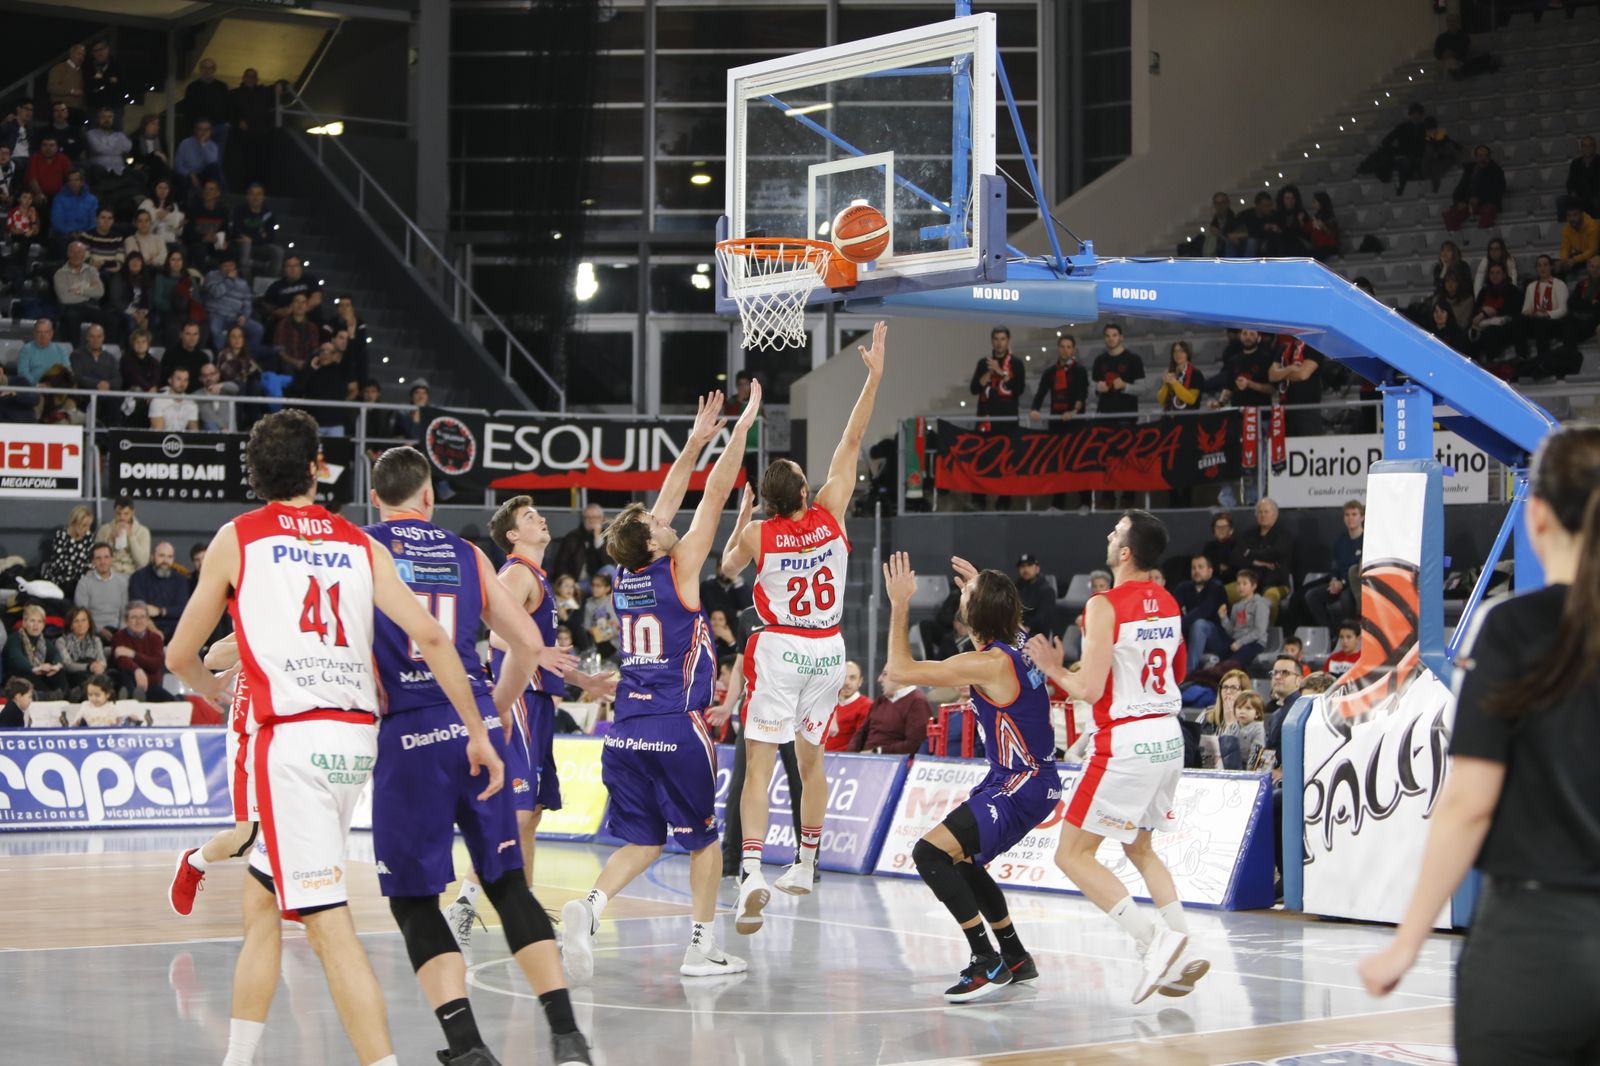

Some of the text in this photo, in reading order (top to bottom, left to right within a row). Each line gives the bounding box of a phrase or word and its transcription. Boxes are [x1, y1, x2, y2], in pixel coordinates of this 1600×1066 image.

[972, 287, 1019, 301] MONDO
[1112, 287, 1157, 301] MONDO
[1396, 398, 1406, 451] MONDO
[483, 422, 732, 472] ESQUINA
[0, 441, 79, 470] ar
[1289, 444, 1486, 477] Diario Ptino
[119, 463, 226, 481] DONDE DANI
[1, 477, 57, 489] MEGAFONÍA
[120, 488, 225, 498] GASTROBAR
[1308, 487, 1337, 496] Cuando
[278, 514, 333, 536] OLMOS
[390, 526, 446, 541] GUSTYS
[775, 525, 832, 548] CARLINHOS
[272, 545, 352, 568] PULEVA
[416, 550, 457, 558] Palencia
[780, 549, 832, 571] PULEVA
[623, 581, 652, 590] Palencia
[787, 566, 836, 616] 26
[299, 575, 349, 647] 41
[621, 613, 662, 656] 10
[1136, 626, 1174, 641] PULEVA
[782, 651, 812, 667] CAJA
[296, 675, 317, 687] DE
[97, 735, 175, 749] técnicas
[400, 728, 451, 750] Diario
[625, 738, 677, 752] Palentino
[1134, 741, 1163, 755] CAJA
[311, 752, 347, 770] CAJA
[106, 806, 210, 819] vicapal@vicapal.es
[292, 866, 333, 880] Granada
[998, 863, 1046, 882] 370
[302, 876, 334, 890] Digital
